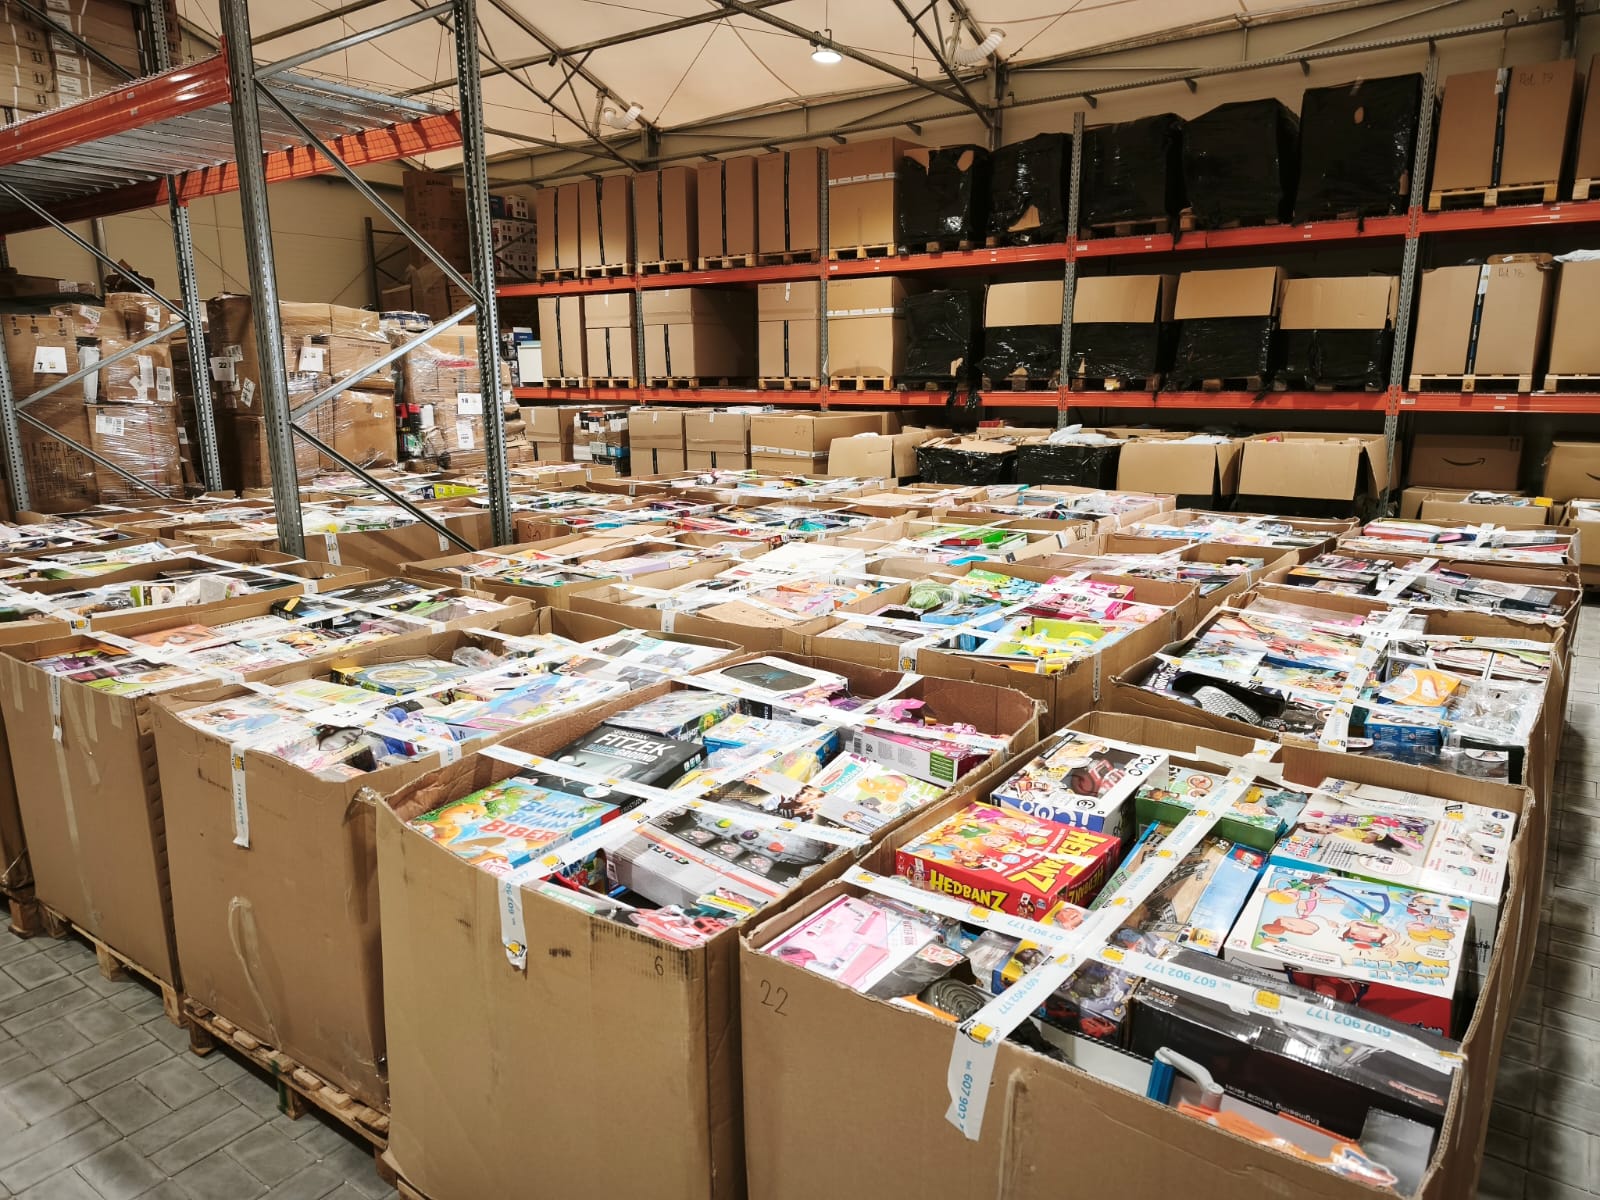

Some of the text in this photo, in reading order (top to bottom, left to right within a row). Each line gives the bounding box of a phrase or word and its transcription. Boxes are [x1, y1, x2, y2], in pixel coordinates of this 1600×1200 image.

[594, 734, 676, 757] FITZEK
[506, 811, 570, 829] BUMM
[519, 800, 585, 819] BUMM
[480, 819, 560, 842] BIBER
[929, 868, 1009, 915] HEDBANZ
[1068, 864, 1104, 905] HEDBANZ
[1006, 919, 1063, 943] 07 902 177
[654, 955, 665, 977] 6
[1144, 960, 1165, 975] 177
[1167, 967, 1191, 981] 902
[1193, 974, 1217, 989] 607
[760, 979, 789, 1017] 22
[997, 998, 1015, 1016] 177
[1305, 1006, 1330, 1022] 177
[1333, 1012, 1361, 1030] 902
[1363, 1018, 1391, 1038] 607
[960, 1072, 973, 1097] 607
[957, 1095, 968, 1120] 902
[1247, 1092, 1274, 1108] Vehicle
[1275, 1102, 1320, 1126] Engineering
